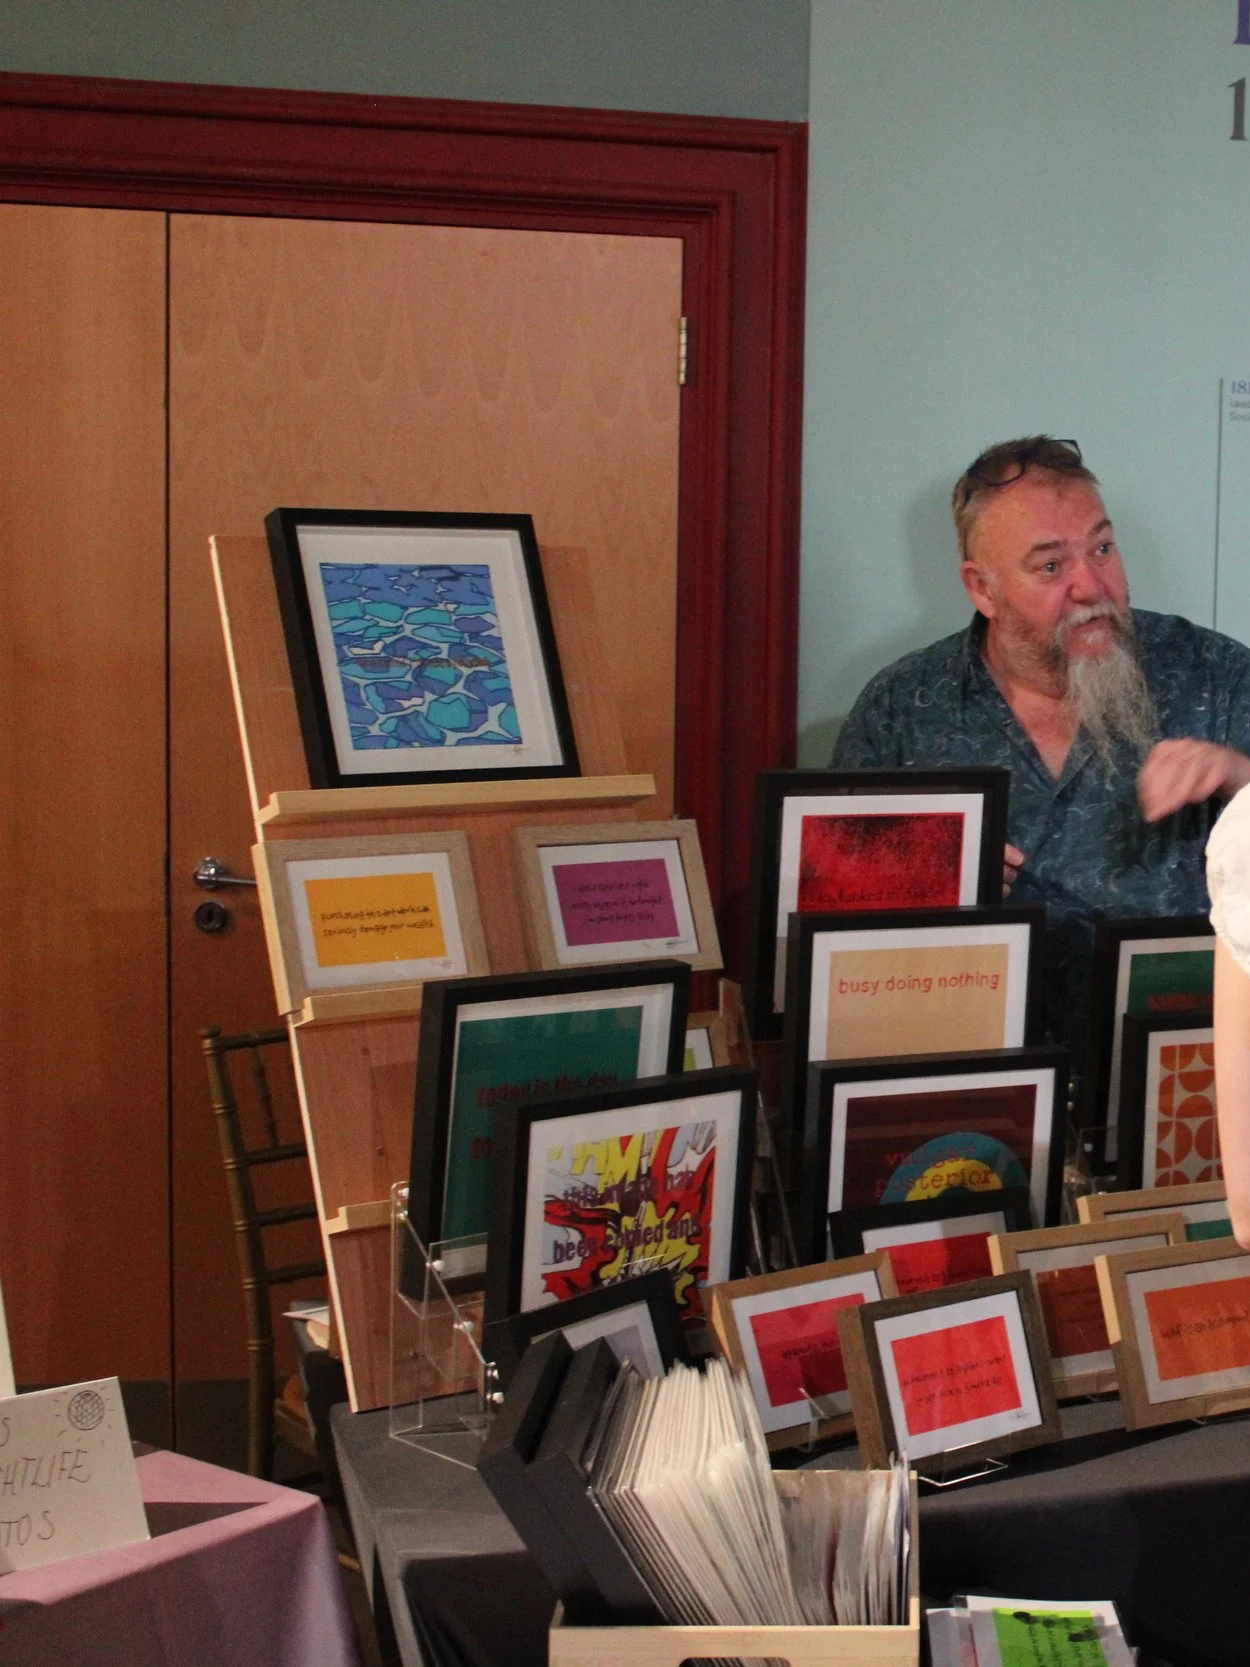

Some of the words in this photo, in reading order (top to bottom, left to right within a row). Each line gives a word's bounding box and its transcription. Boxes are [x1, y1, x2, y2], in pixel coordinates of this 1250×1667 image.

[838, 979, 880, 996] busy
[885, 974, 934, 993] doing
[937, 971, 1000, 991] nothing
[0, 1449, 92, 1497] HTLIFE
